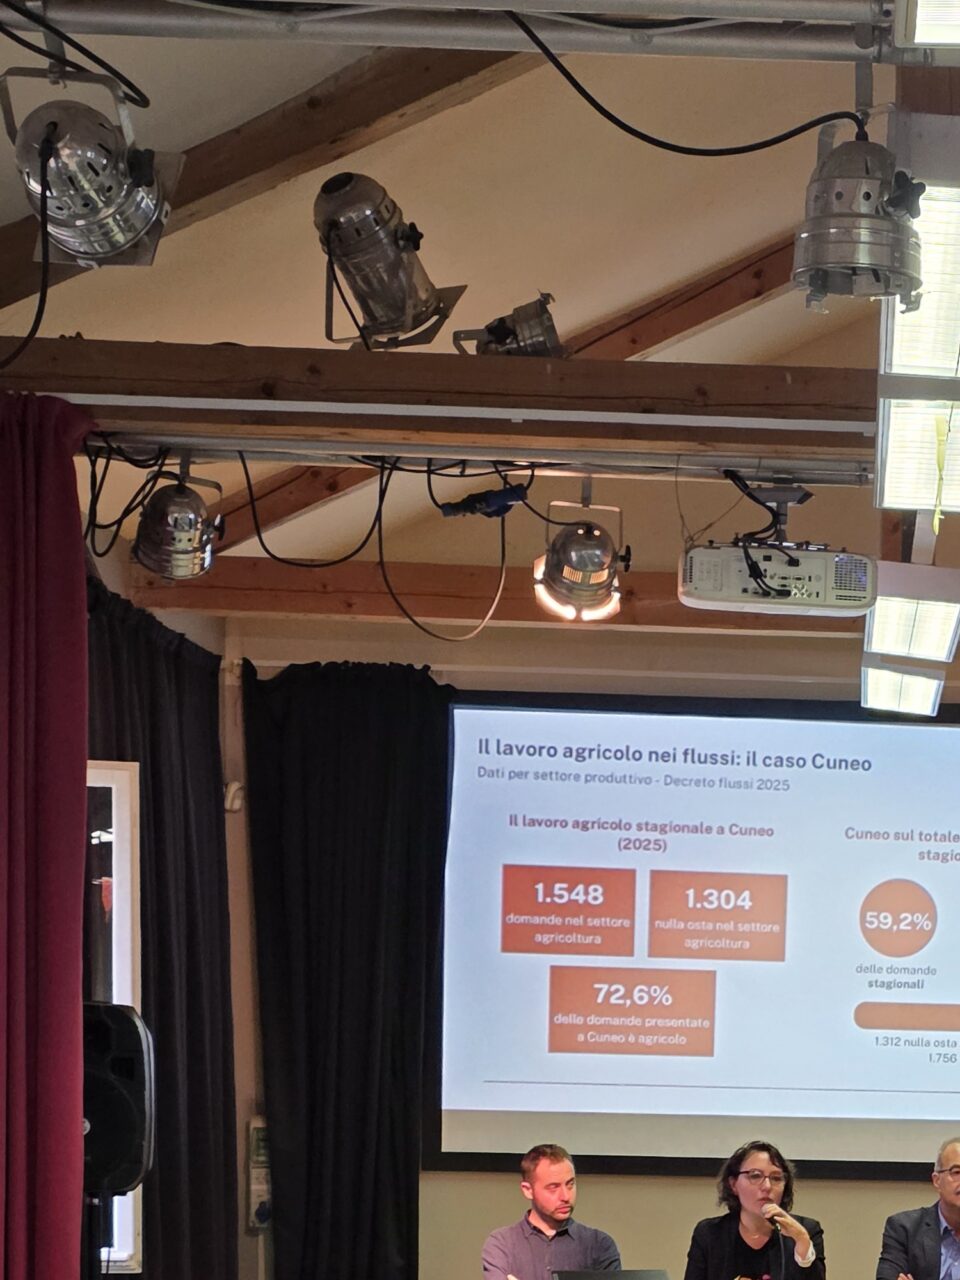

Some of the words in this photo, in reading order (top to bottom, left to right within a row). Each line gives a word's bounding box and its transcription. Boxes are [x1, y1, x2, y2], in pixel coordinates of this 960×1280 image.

[478, 737, 489, 755] Il
[496, 738, 558, 757] lavoro
[563, 743, 643, 763] agricolo
[648, 746, 677, 763] nei
[682, 747, 741, 766] flussi:
[746, 750, 758, 767] il
[762, 754, 807, 769] caso
[812, 752, 872, 771] Cuneo
[477, 766, 505, 778] Dati
[508, 768, 530, 781] per
[533, 770, 581, 782] settore
[584, 772, 652, 785] produttivo
[663, 774, 715, 788] Decreto
[719, 777, 754, 789] flussi
[756, 778, 790, 791] 2025
[509, 814, 518, 827] Il
[522, 814, 569, 829] lavoro
[572, 817, 633, 832] agricolo
[636, 821, 713, 835] stagionale
[716, 827, 725, 835] a
[729, 823, 775, 837] Cuneo
[845, 826, 890, 841] Cuneo
[894, 828, 914, 842] sul
[918, 830, 960, 844] totale
[617, 837, 667, 852] (2025)
[534, 882, 604, 905] 1.548
[685, 888, 752, 910] 1.304
[505, 912, 562, 926] domande
[565, 914, 584, 926] nel
[587, 916, 631, 928] settore
[654, 918, 685, 930] nulla
[687, 920, 713, 931] osta
[716, 920, 734, 932] nel
[737, 922, 780, 933] settore
[864, 912, 932, 932] 59,2%
[534, 932, 601, 945] agricoltura
[684, 937, 750, 950] agricoltura
[856, 964, 883, 975] delle
[886, 965, 937, 976] domande
[868, 978, 924, 991] stagionali
[593, 983, 672, 1008] 72,6%
[554, 1013, 583, 1025] delle
[587, 1014, 642, 1026] domande
[645, 1016, 710, 1029] presentate
[577, 1034, 584, 1042] a
[587, 1031, 625, 1043] Cuneo
[628, 1032, 635, 1043] è
[638, 1033, 687, 1046] agricolo
[875, 1037, 901, 1048] 1.312
[904, 1038, 931, 1049] nulla
[933, 1039, 957, 1049] osta
[928, 1054, 957, 1064] 1.756
